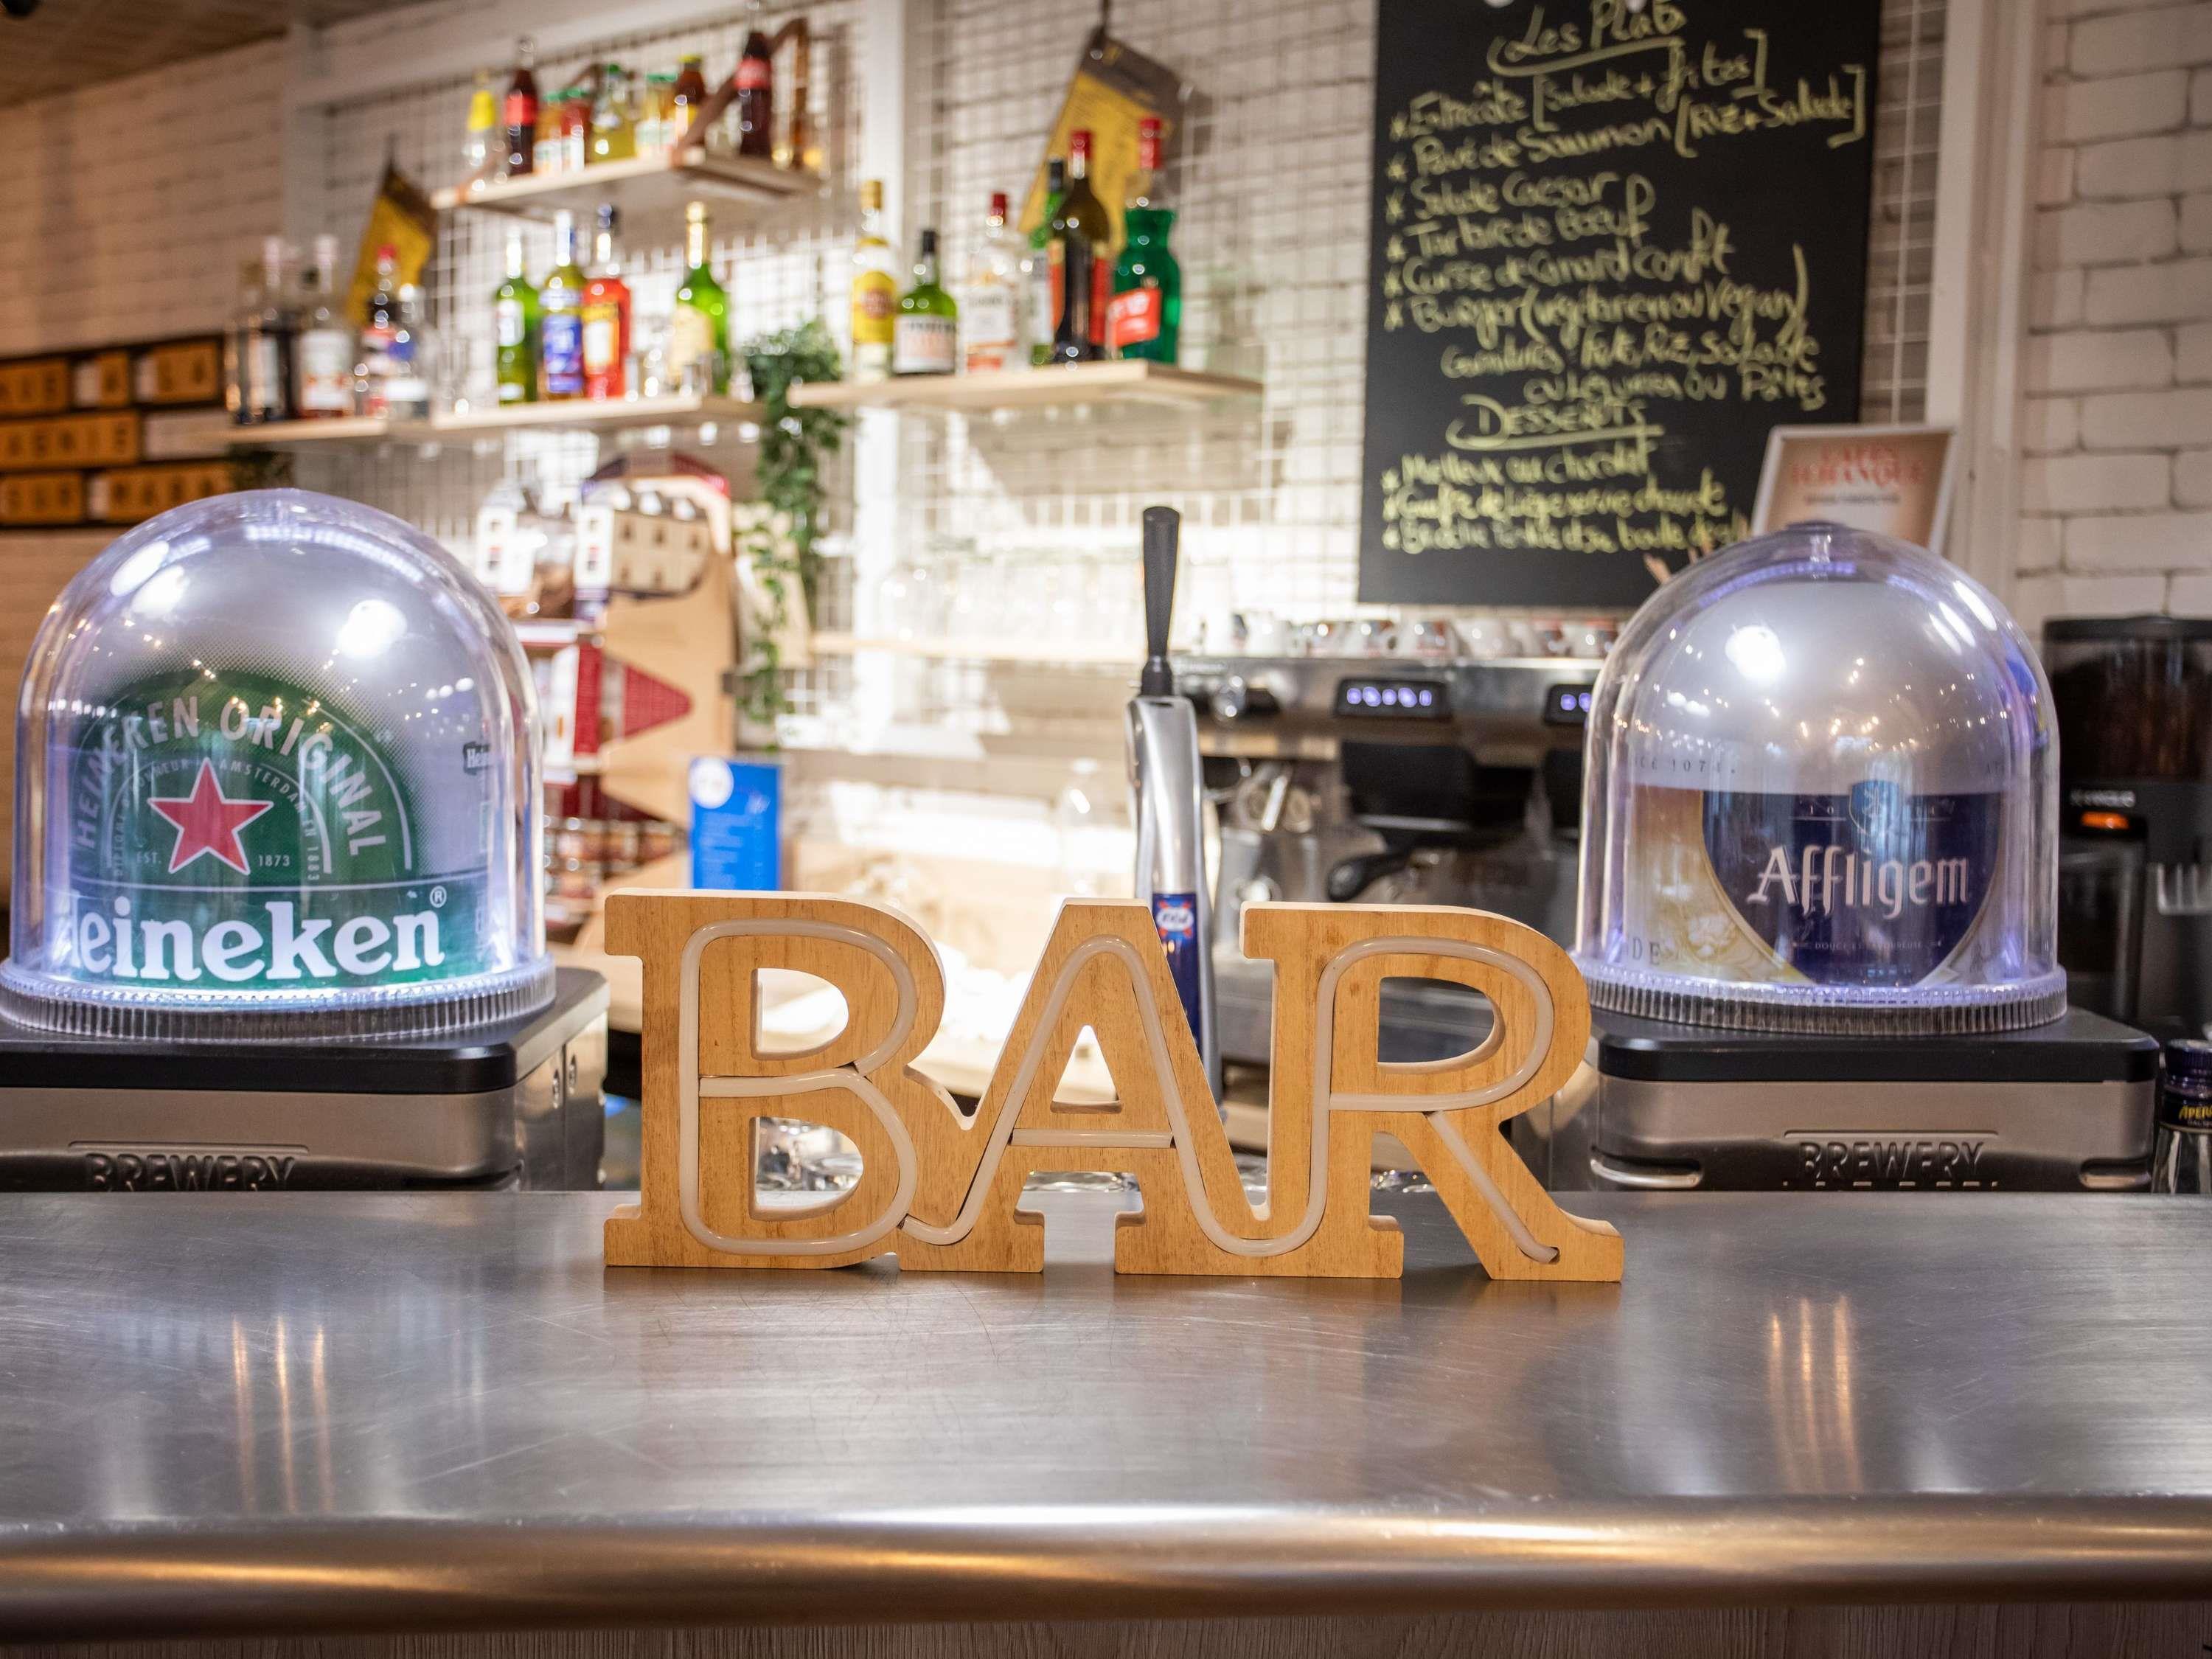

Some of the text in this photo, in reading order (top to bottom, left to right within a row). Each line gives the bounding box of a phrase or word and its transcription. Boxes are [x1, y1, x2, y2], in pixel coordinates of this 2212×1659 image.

[1506, 4, 1582, 61] Les
[1516, 116, 1672, 164] Saumon
[220, 698, 386, 857] ORIGINAL
[136, 852, 291, 867] EST. 1873
[1745, 844, 1970, 920] Affligem
[604, 887, 1624, 1283] BAR
[85, 1152, 295, 1191] BREWERY
[1798, 1141, 1984, 1180] BREWERY
